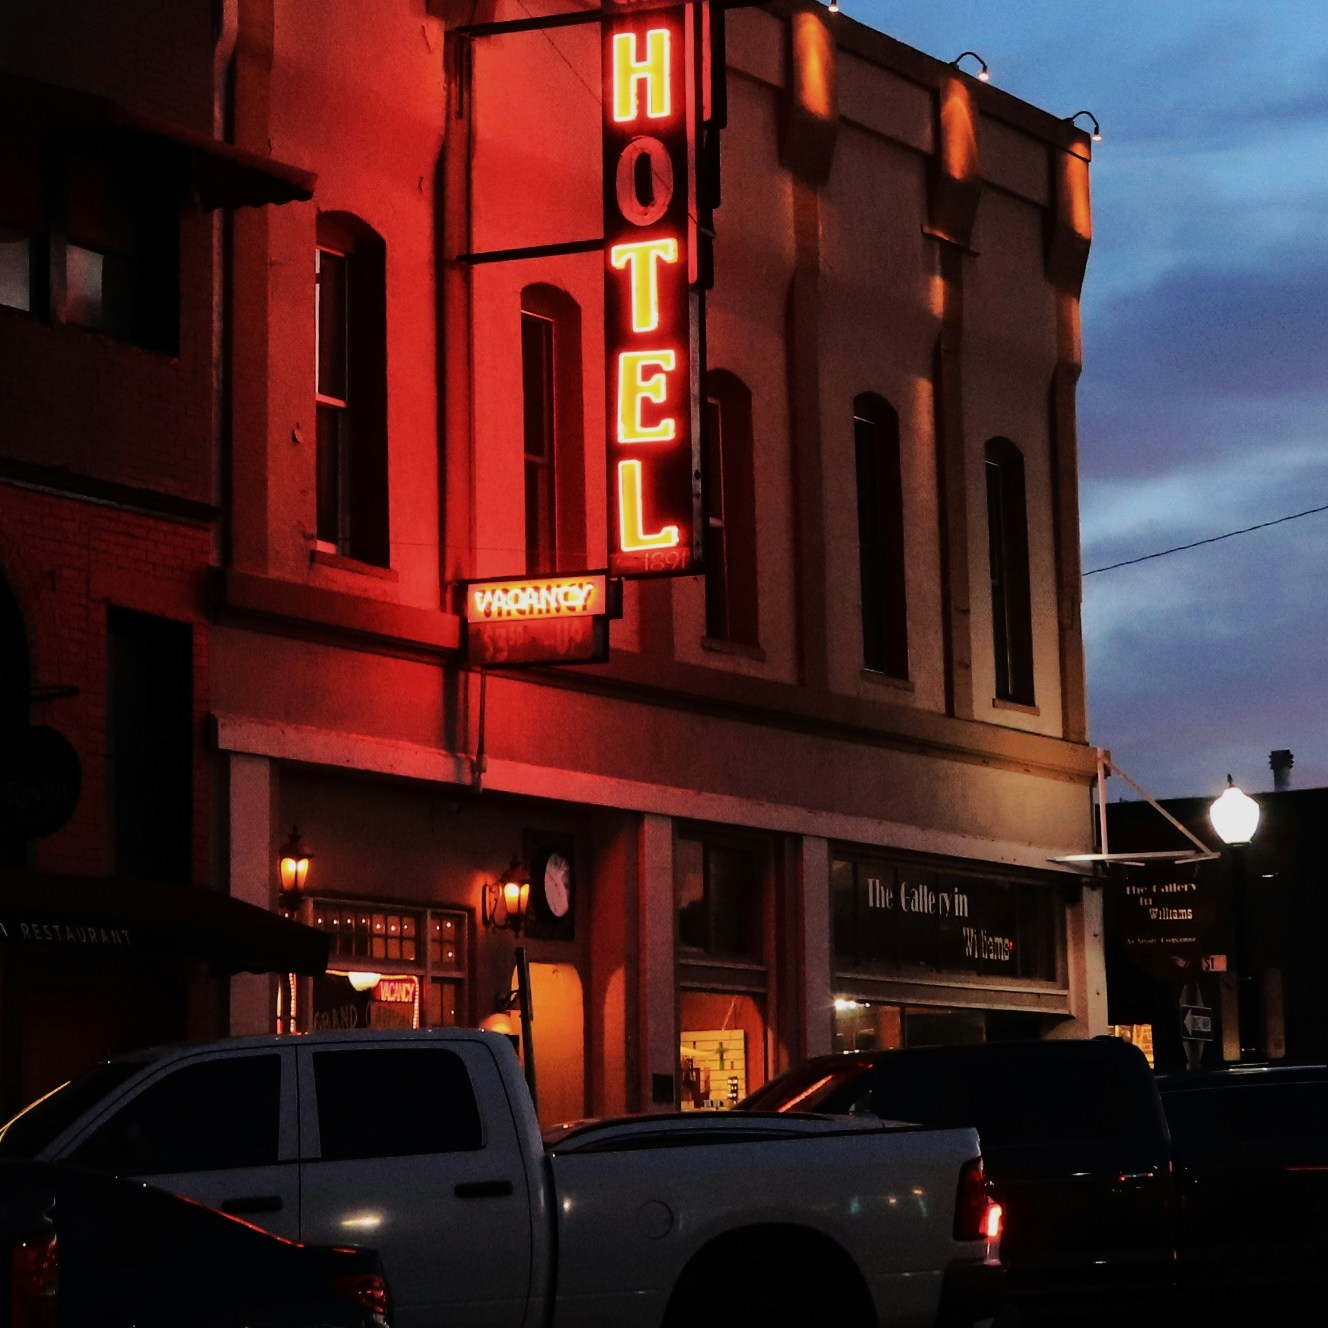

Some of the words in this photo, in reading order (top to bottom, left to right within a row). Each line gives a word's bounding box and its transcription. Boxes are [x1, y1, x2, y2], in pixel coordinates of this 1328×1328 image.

[611, 28, 679, 552] HOTEL
[644, 551, 686, 571] 1891
[474, 581, 595, 618] VACANCY
[867, 878, 894, 910] The
[900, 881, 952, 918] Gallery
[954, 885, 969, 917] in
[1148, 907, 1193, 921] Williams
[21, 922, 133, 946] RESTAURANT
[962, 926, 1011, 962] Wiliams
[379, 981, 414, 1003] VACANCY
